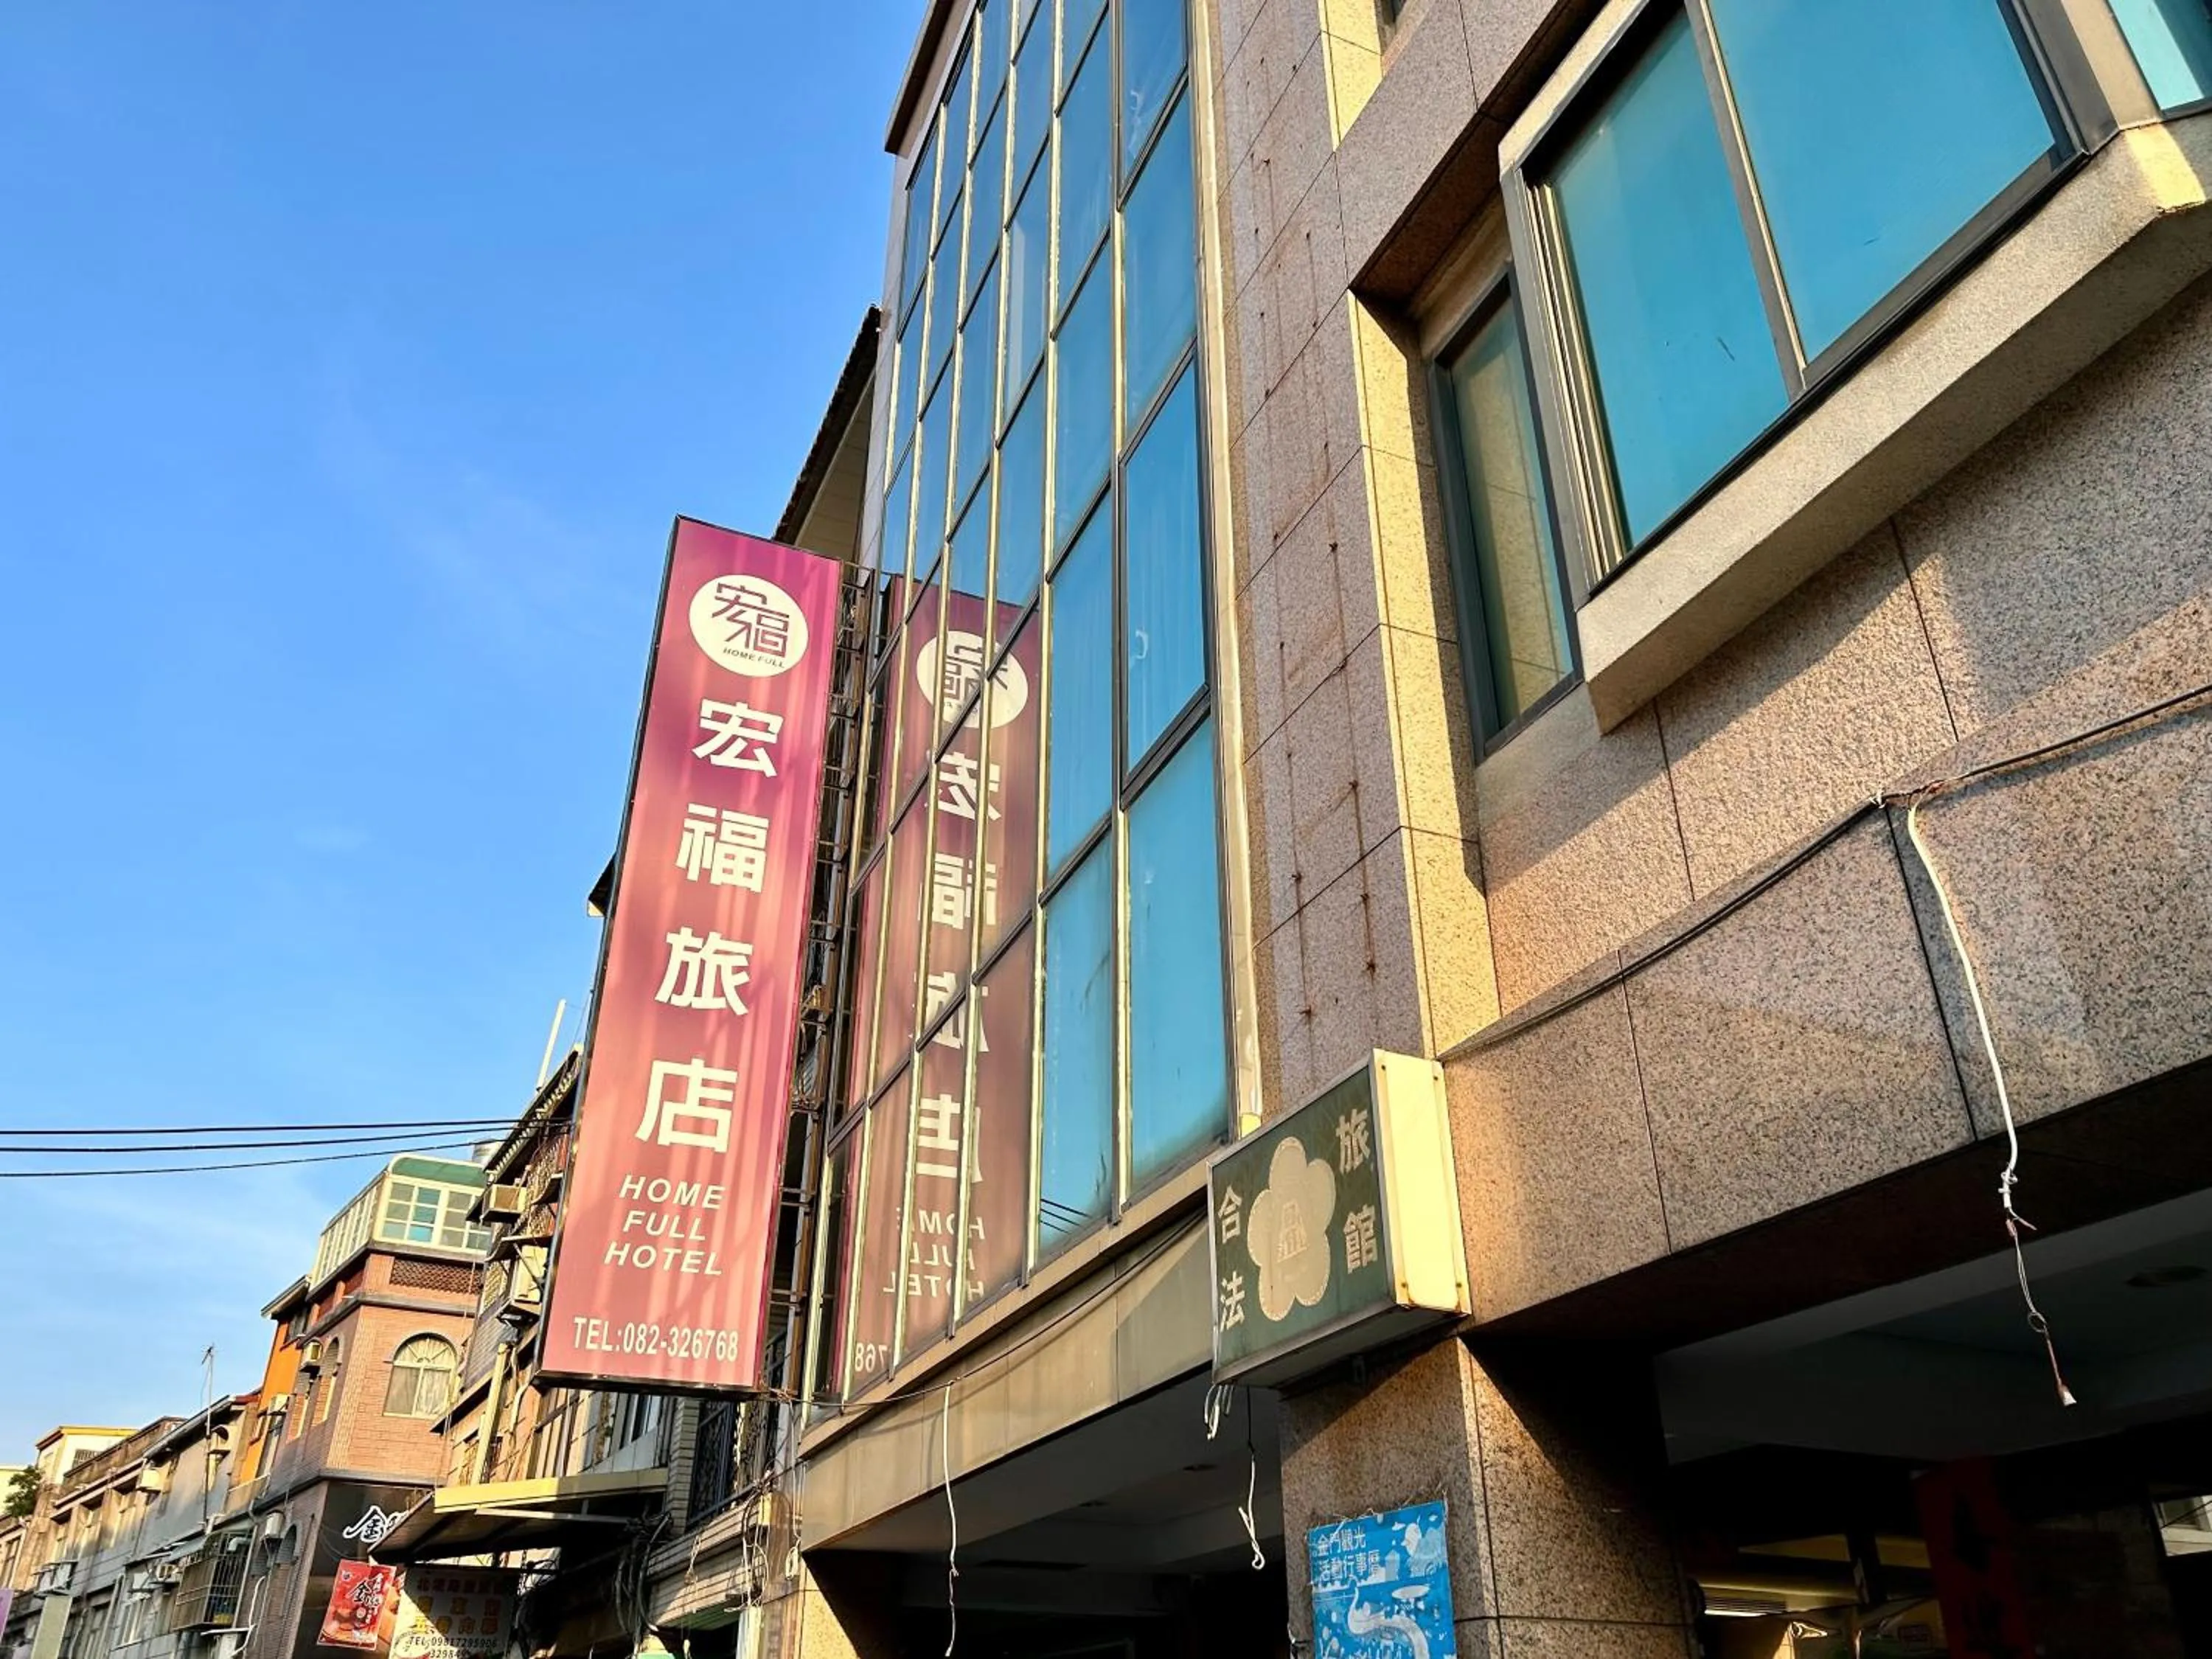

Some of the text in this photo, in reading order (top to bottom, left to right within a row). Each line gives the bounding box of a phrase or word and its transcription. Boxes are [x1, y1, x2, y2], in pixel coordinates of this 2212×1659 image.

[723, 647, 785, 669] HOME FULL
[636, 698, 784, 1153] 宏福旅店
[619, 1175, 726, 1211] HOME
[1335, 1107, 1379, 1274] 旅館
[623, 1209, 706, 1242] FULL
[603, 1241, 723, 1276] HOTEL
[1217, 1185, 1245, 1332] 合法
